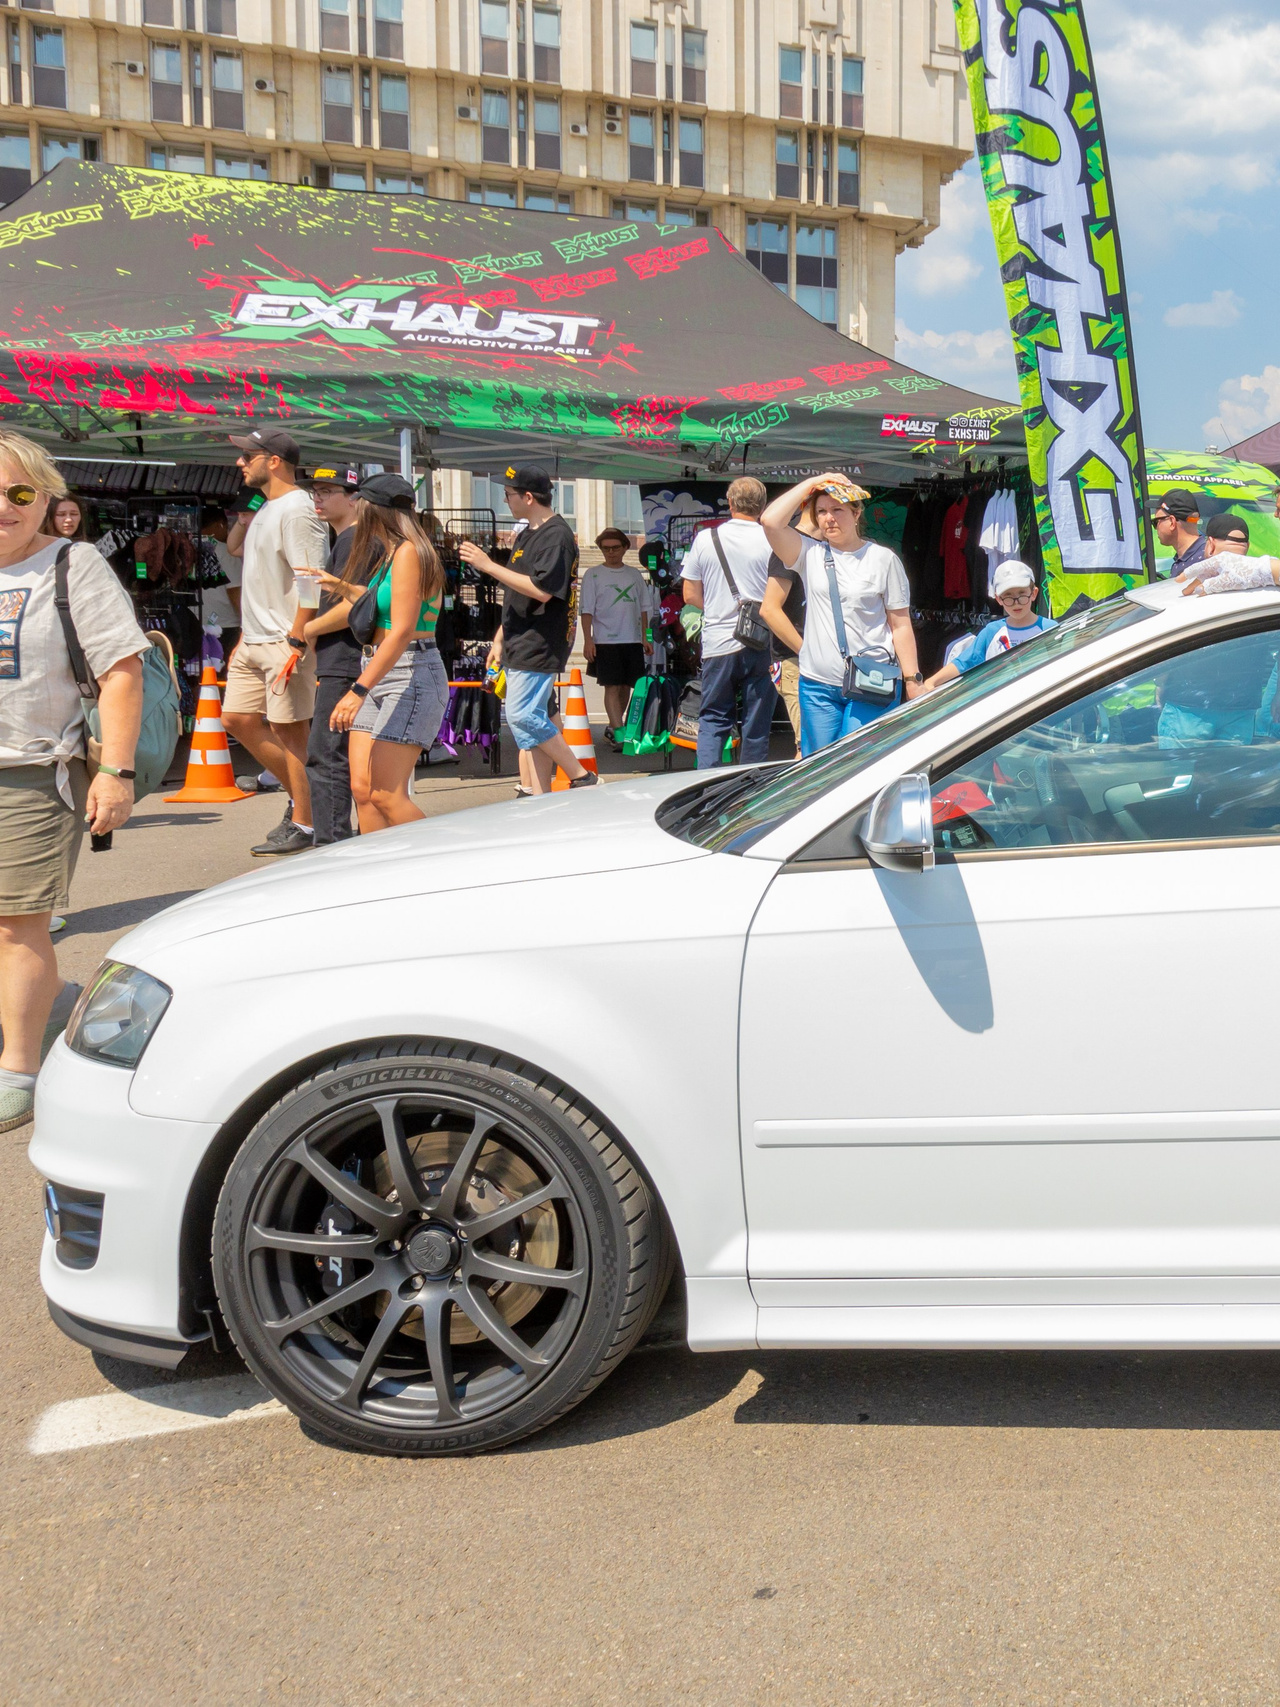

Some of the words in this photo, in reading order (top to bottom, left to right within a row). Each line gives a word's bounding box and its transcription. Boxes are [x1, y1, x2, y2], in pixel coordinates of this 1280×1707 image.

[0, 203, 104, 248] EXHAUST
[551, 223, 640, 263] EXHAUST
[453, 251, 543, 284] EXHAUST
[623, 238, 710, 279] EXHAUST
[977, 0, 1143, 572] EXHAUS
[232, 288, 601, 346] EXHAUST
[403, 333, 517, 350] AUTOMOTIVE
[521, 343, 592, 356] APPAREL
[881, 416, 939, 435] EXHAUST
[948, 427, 990, 440] EXHST.RU
[969, 419, 990, 429] EXHST
[1204, 475, 1246, 487] APPAREL
[351, 1067, 454, 1089] MICHELIN
[464, 1076, 505, 1097] 225/40
[384, 1430, 487, 1451] MICHELIN
